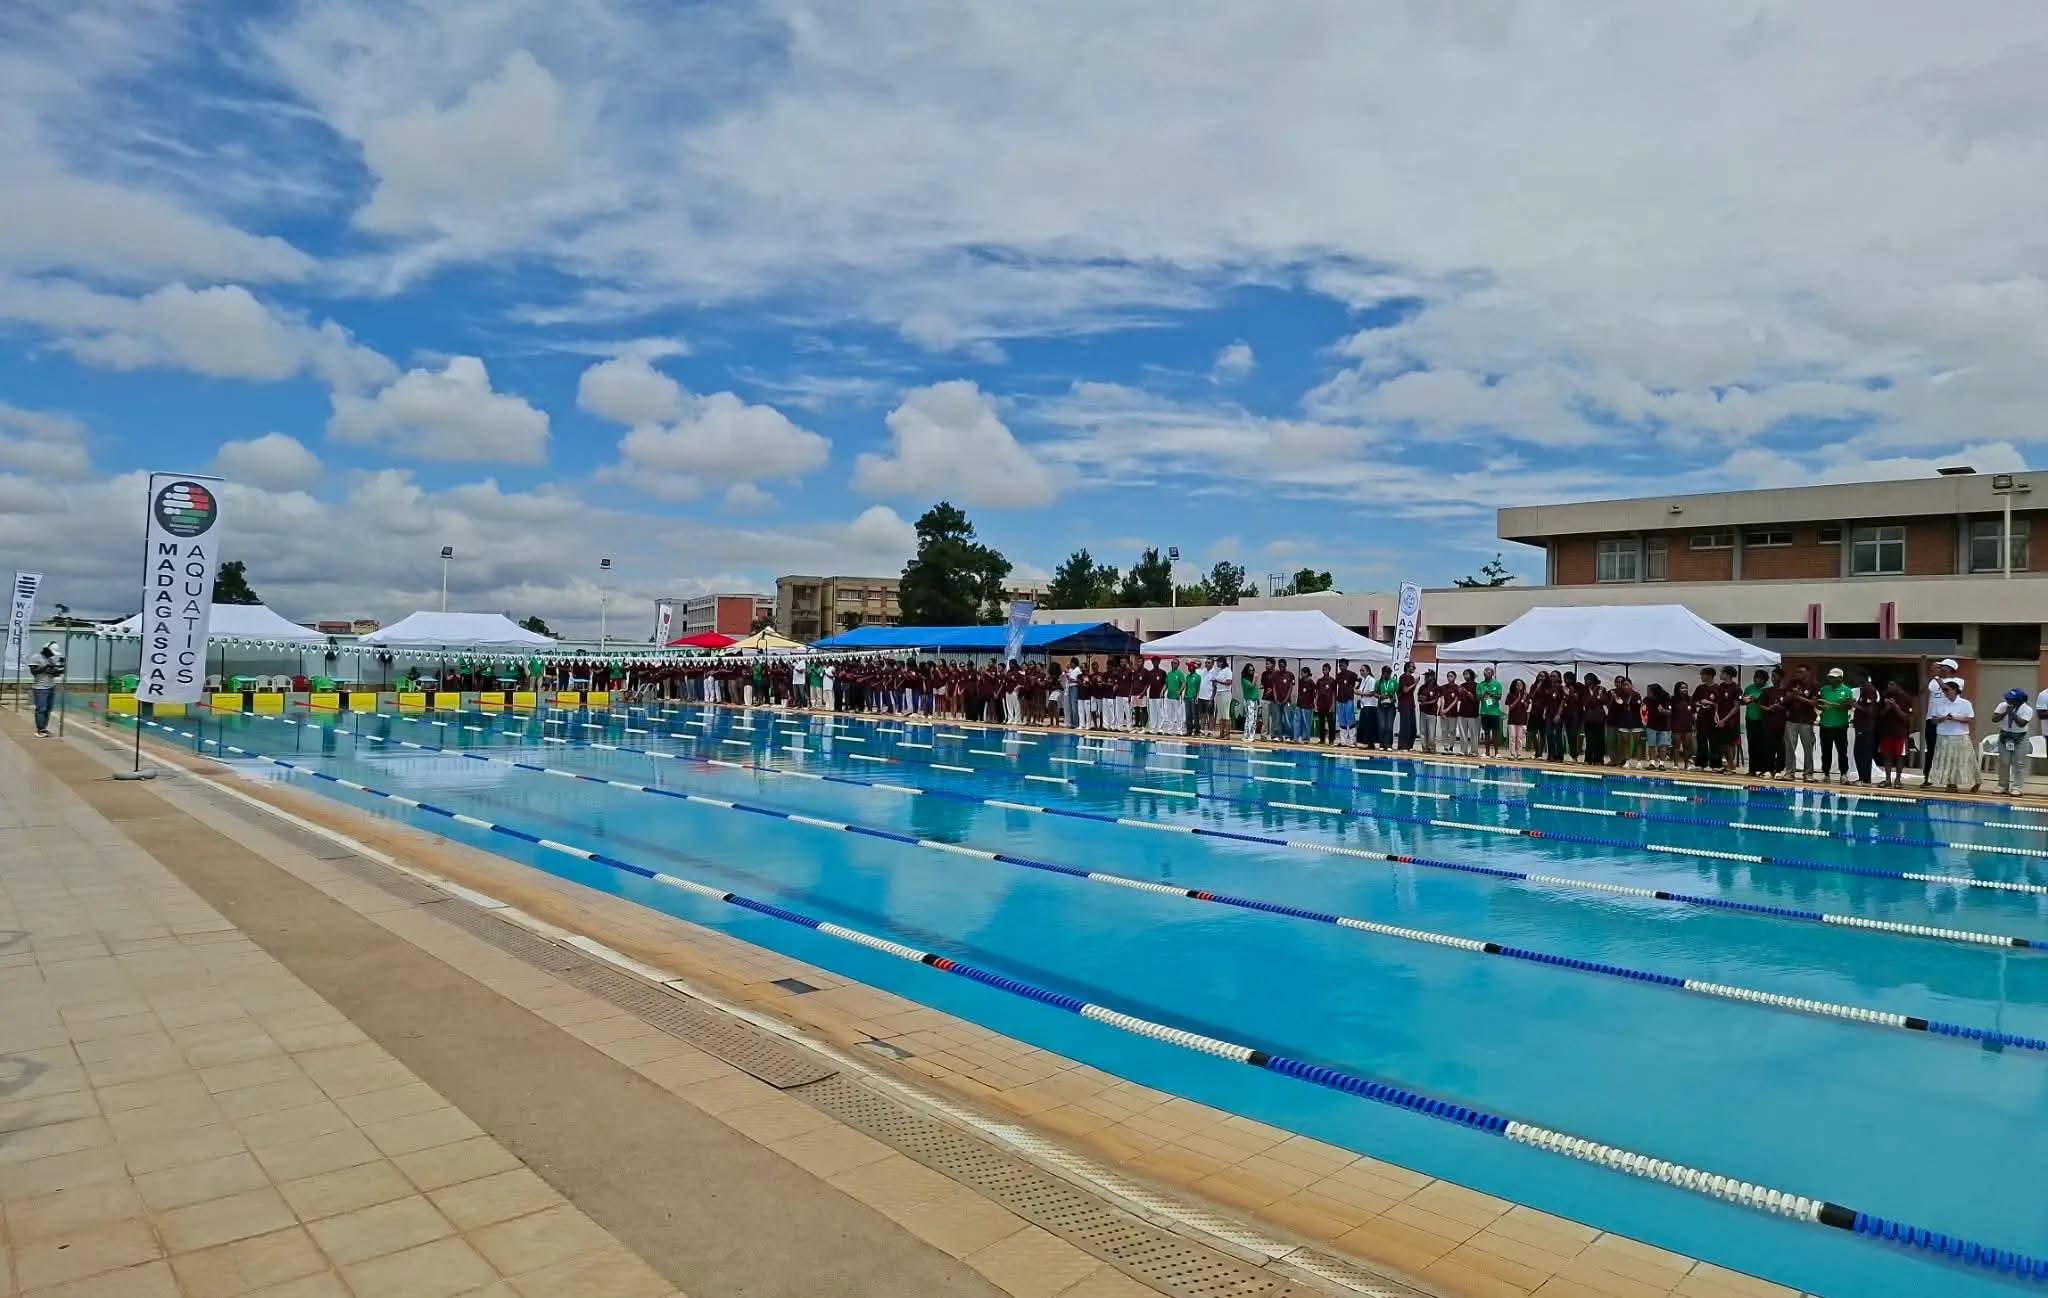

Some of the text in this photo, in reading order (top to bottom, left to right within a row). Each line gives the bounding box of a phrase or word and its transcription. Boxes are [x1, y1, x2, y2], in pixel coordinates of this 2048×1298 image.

[12, 602, 25, 645] WORLD
[148, 543, 178, 696] MADAGASCAR
[177, 545, 205, 684] AQUATICS
